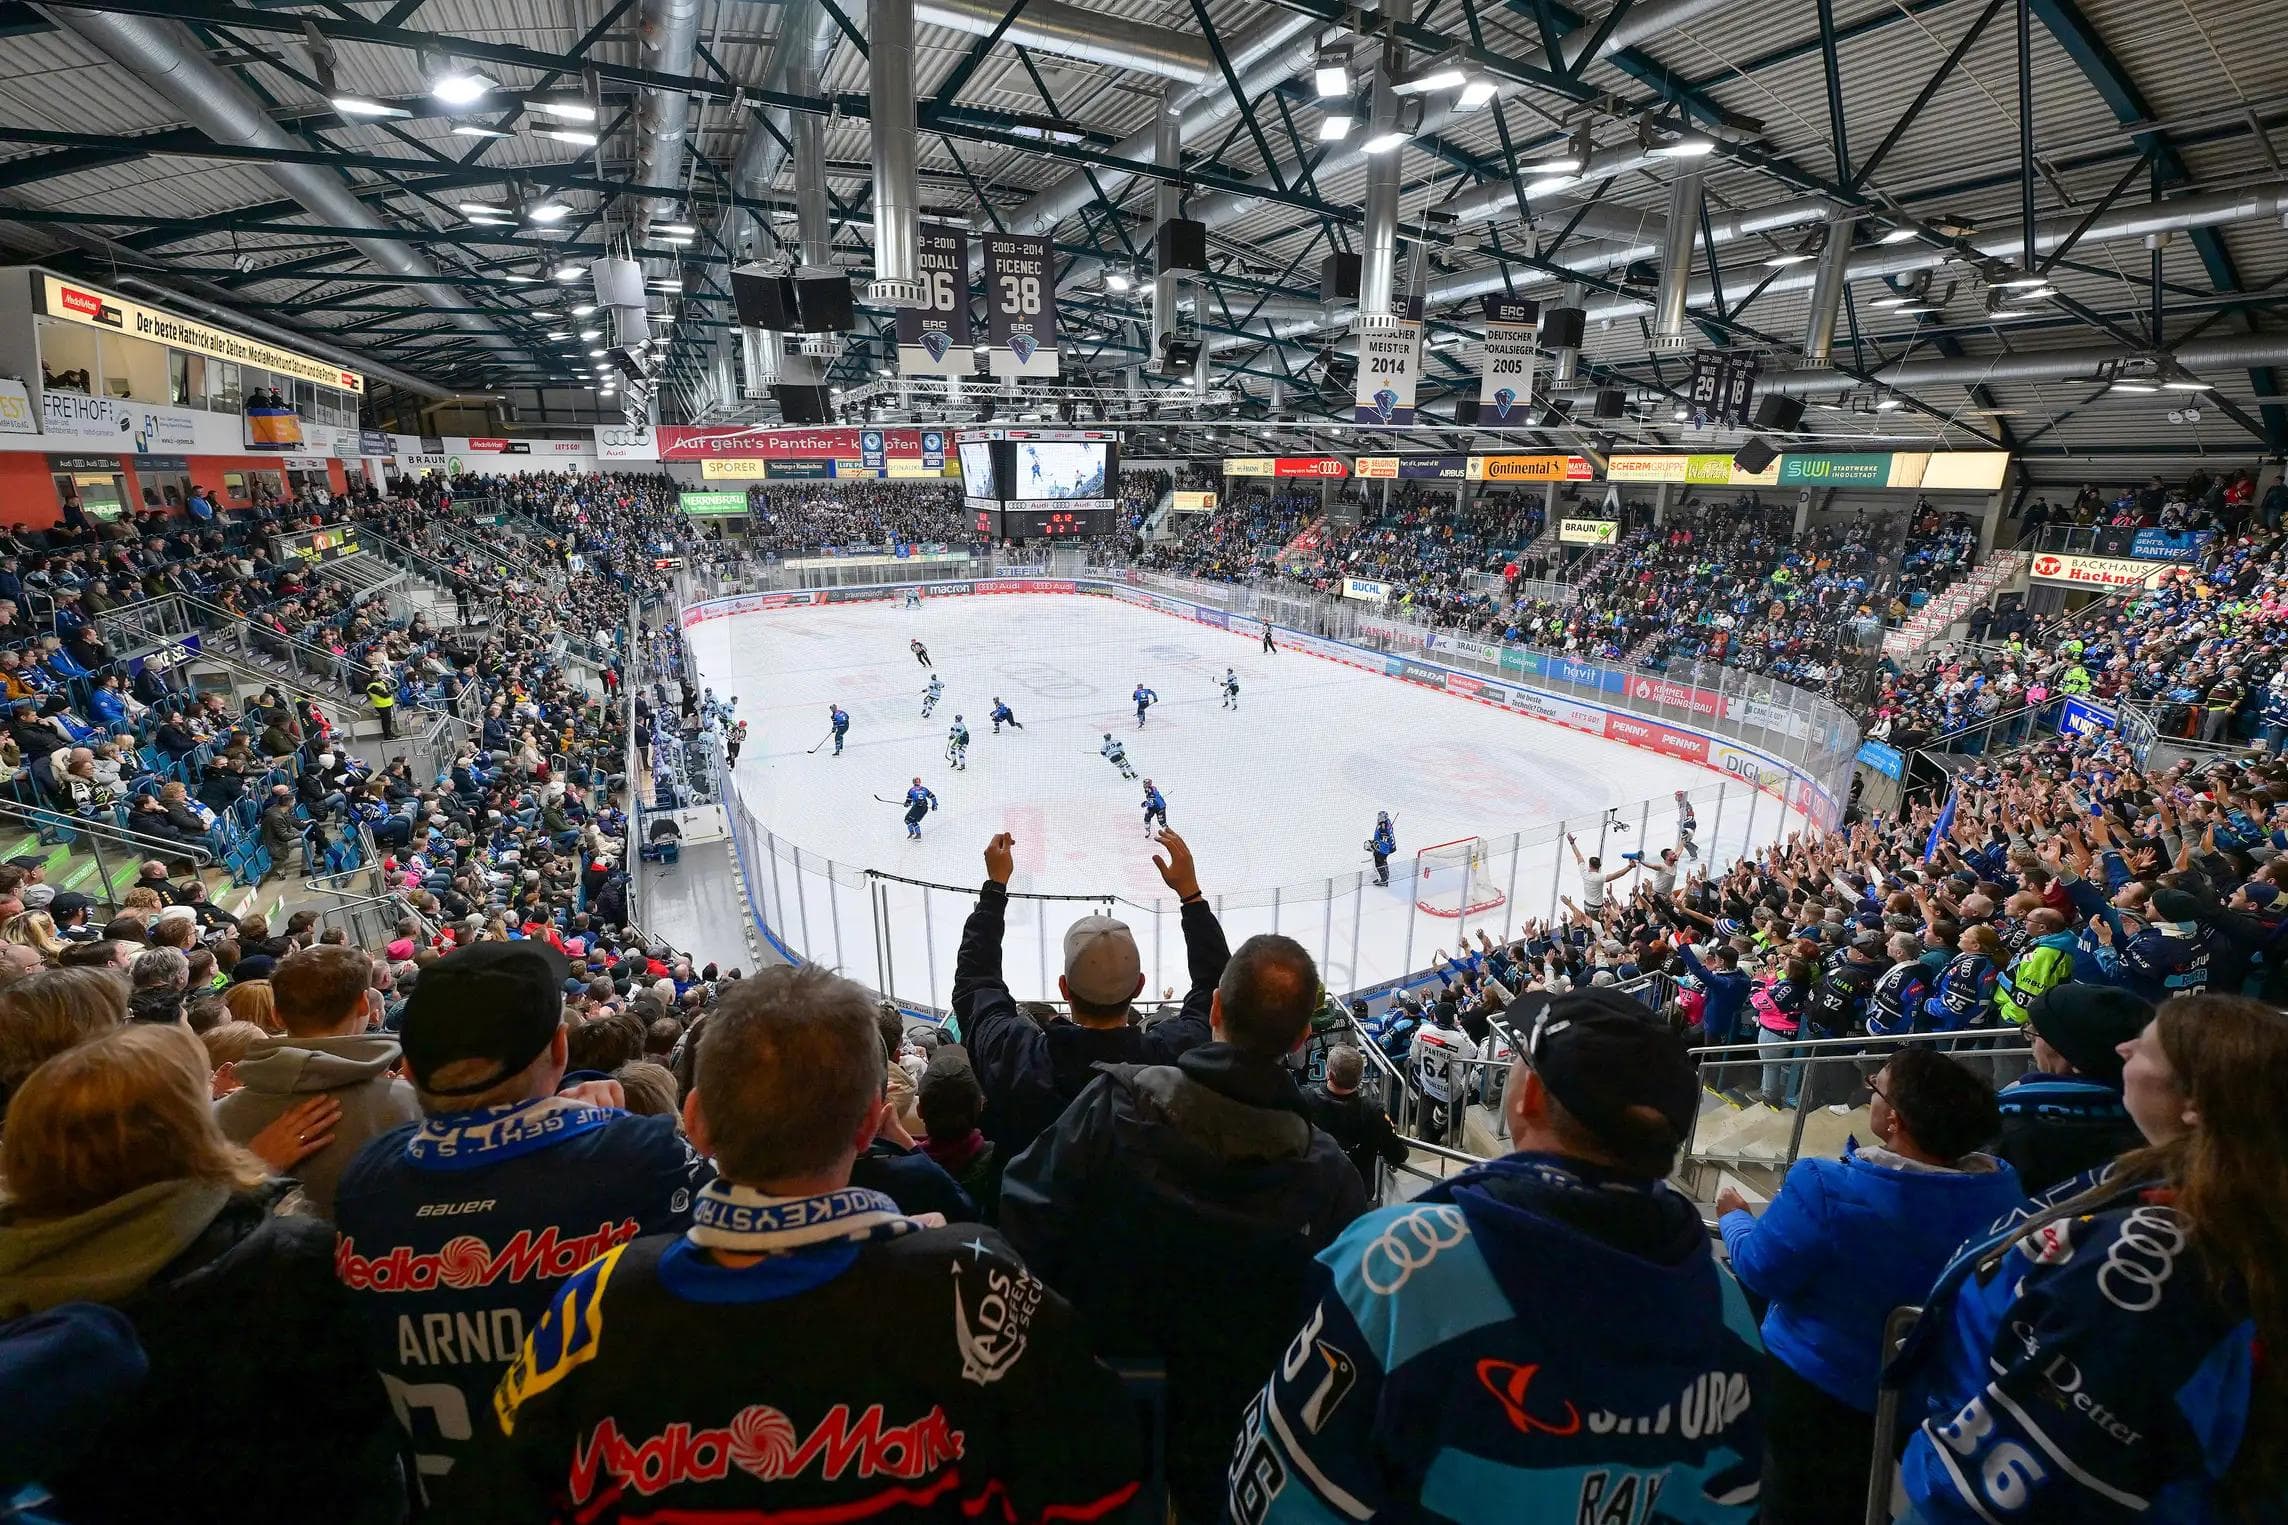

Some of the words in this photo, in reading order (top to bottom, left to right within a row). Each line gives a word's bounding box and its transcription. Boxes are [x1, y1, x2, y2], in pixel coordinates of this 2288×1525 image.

[919, 254, 959, 270] ODALL
[996, 259, 1042, 275] FICENEC
[1000, 276, 1041, 315] 38
[1500, 305, 1525, 316] ERC
[922, 320, 947, 328] ERC
[1010, 324, 1033, 332] ERC
[137, 312, 153, 333] Der
[154, 319, 178, 340] beste
[179, 325, 210, 349] Hattrick
[210, 334, 226, 353] aller
[226, 339, 247, 359] Zeiten:
[248, 345, 282, 368] MediaMarkt
[1366, 329, 1416, 340] SCHER
[1488, 330, 1532, 342] DEUTSCHER
[1369, 342, 1410, 354] MEISTER
[1485, 344, 1535, 356] POKALSIEGER
[1371, 357, 1406, 374] 2014
[1492, 359, 1523, 374] 2005
[1695, 376, 1715, 401] 29
[1731, 380, 1745, 404] 18
[555, 443, 570, 451] LET'S
[675, 437, 705, 448] Auf
[769, 437, 833, 449] Panther
[851, 439, 918, 452] kpfen
[60, 459, 72, 468] Audi
[408, 456, 446, 464] BRAUN
[708, 462, 757, 472] SPORER
[1439, 470, 1465, 478] AIRBUS
[1489, 461, 1550, 477] Continental
[1059, 525, 1064, 533] 2
[1565, 522, 1597, 532] BRAUN
[2072, 559, 2150, 574] BACKHAUS
[2068, 570, 2144, 585] Hackner
[930, 584, 970, 594] macron
[1352, 580, 1381, 594] BUCHL
[1406, 666, 1446, 683] MBDA
[1525, 694, 1542, 704] beste
[1653, 684, 1685, 699] KIMMEL
[1652, 694, 1713, 713] HEIZUNGSBAU
[1681, 991, 1693, 1001] 24
[1823, 994, 1843, 1011] 32
[1946, 995, 1966, 1011] 25
[1363, 1022, 1380, 1031] TURN
[1423, 1057, 1449, 1079] 64
[415, 1199, 497, 1217] BAUER
[2043, 1354, 2144, 1447] Detter
